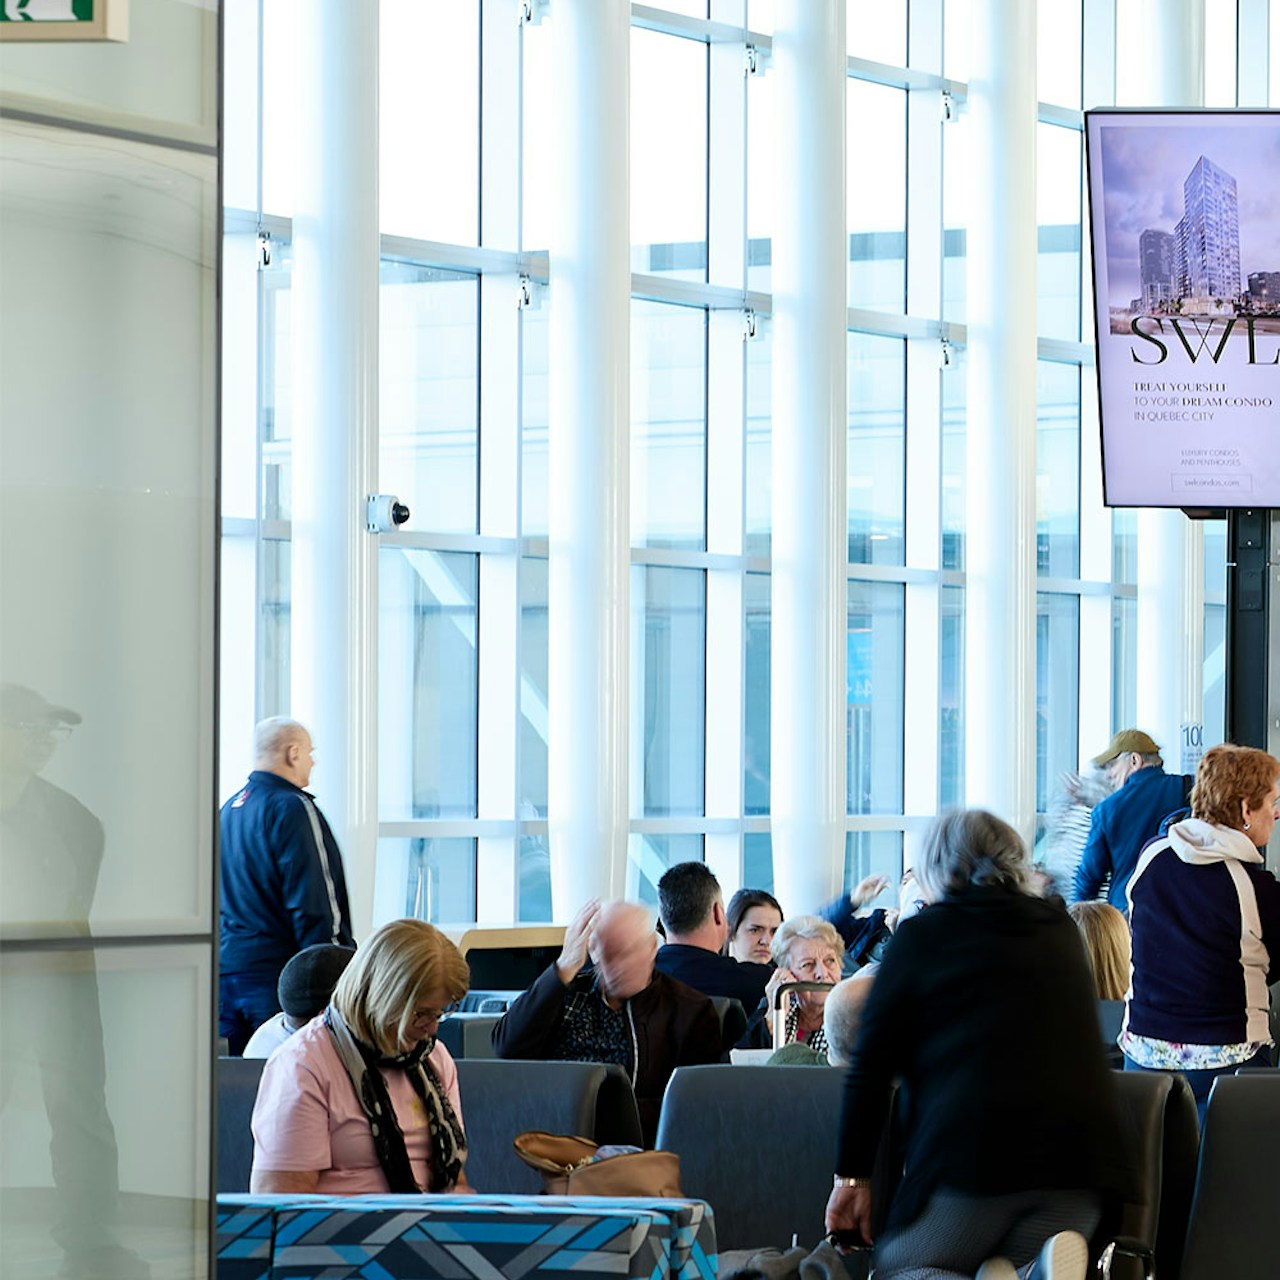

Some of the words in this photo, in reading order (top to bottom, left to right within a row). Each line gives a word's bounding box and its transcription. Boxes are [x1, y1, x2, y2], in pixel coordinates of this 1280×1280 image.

[1131, 315, 1280, 365] SWL
[1134, 383, 1166, 392] TREAT
[1169, 383, 1227, 392] YOURSELF
[1134, 396, 1148, 406] TO
[1151, 396, 1180, 406] YOUR
[1182, 397, 1222, 407] DREAM
[1224, 398, 1273, 408] CONDO
[1134, 411, 1145, 421] IN
[1191, 412, 1215, 422] CITY
